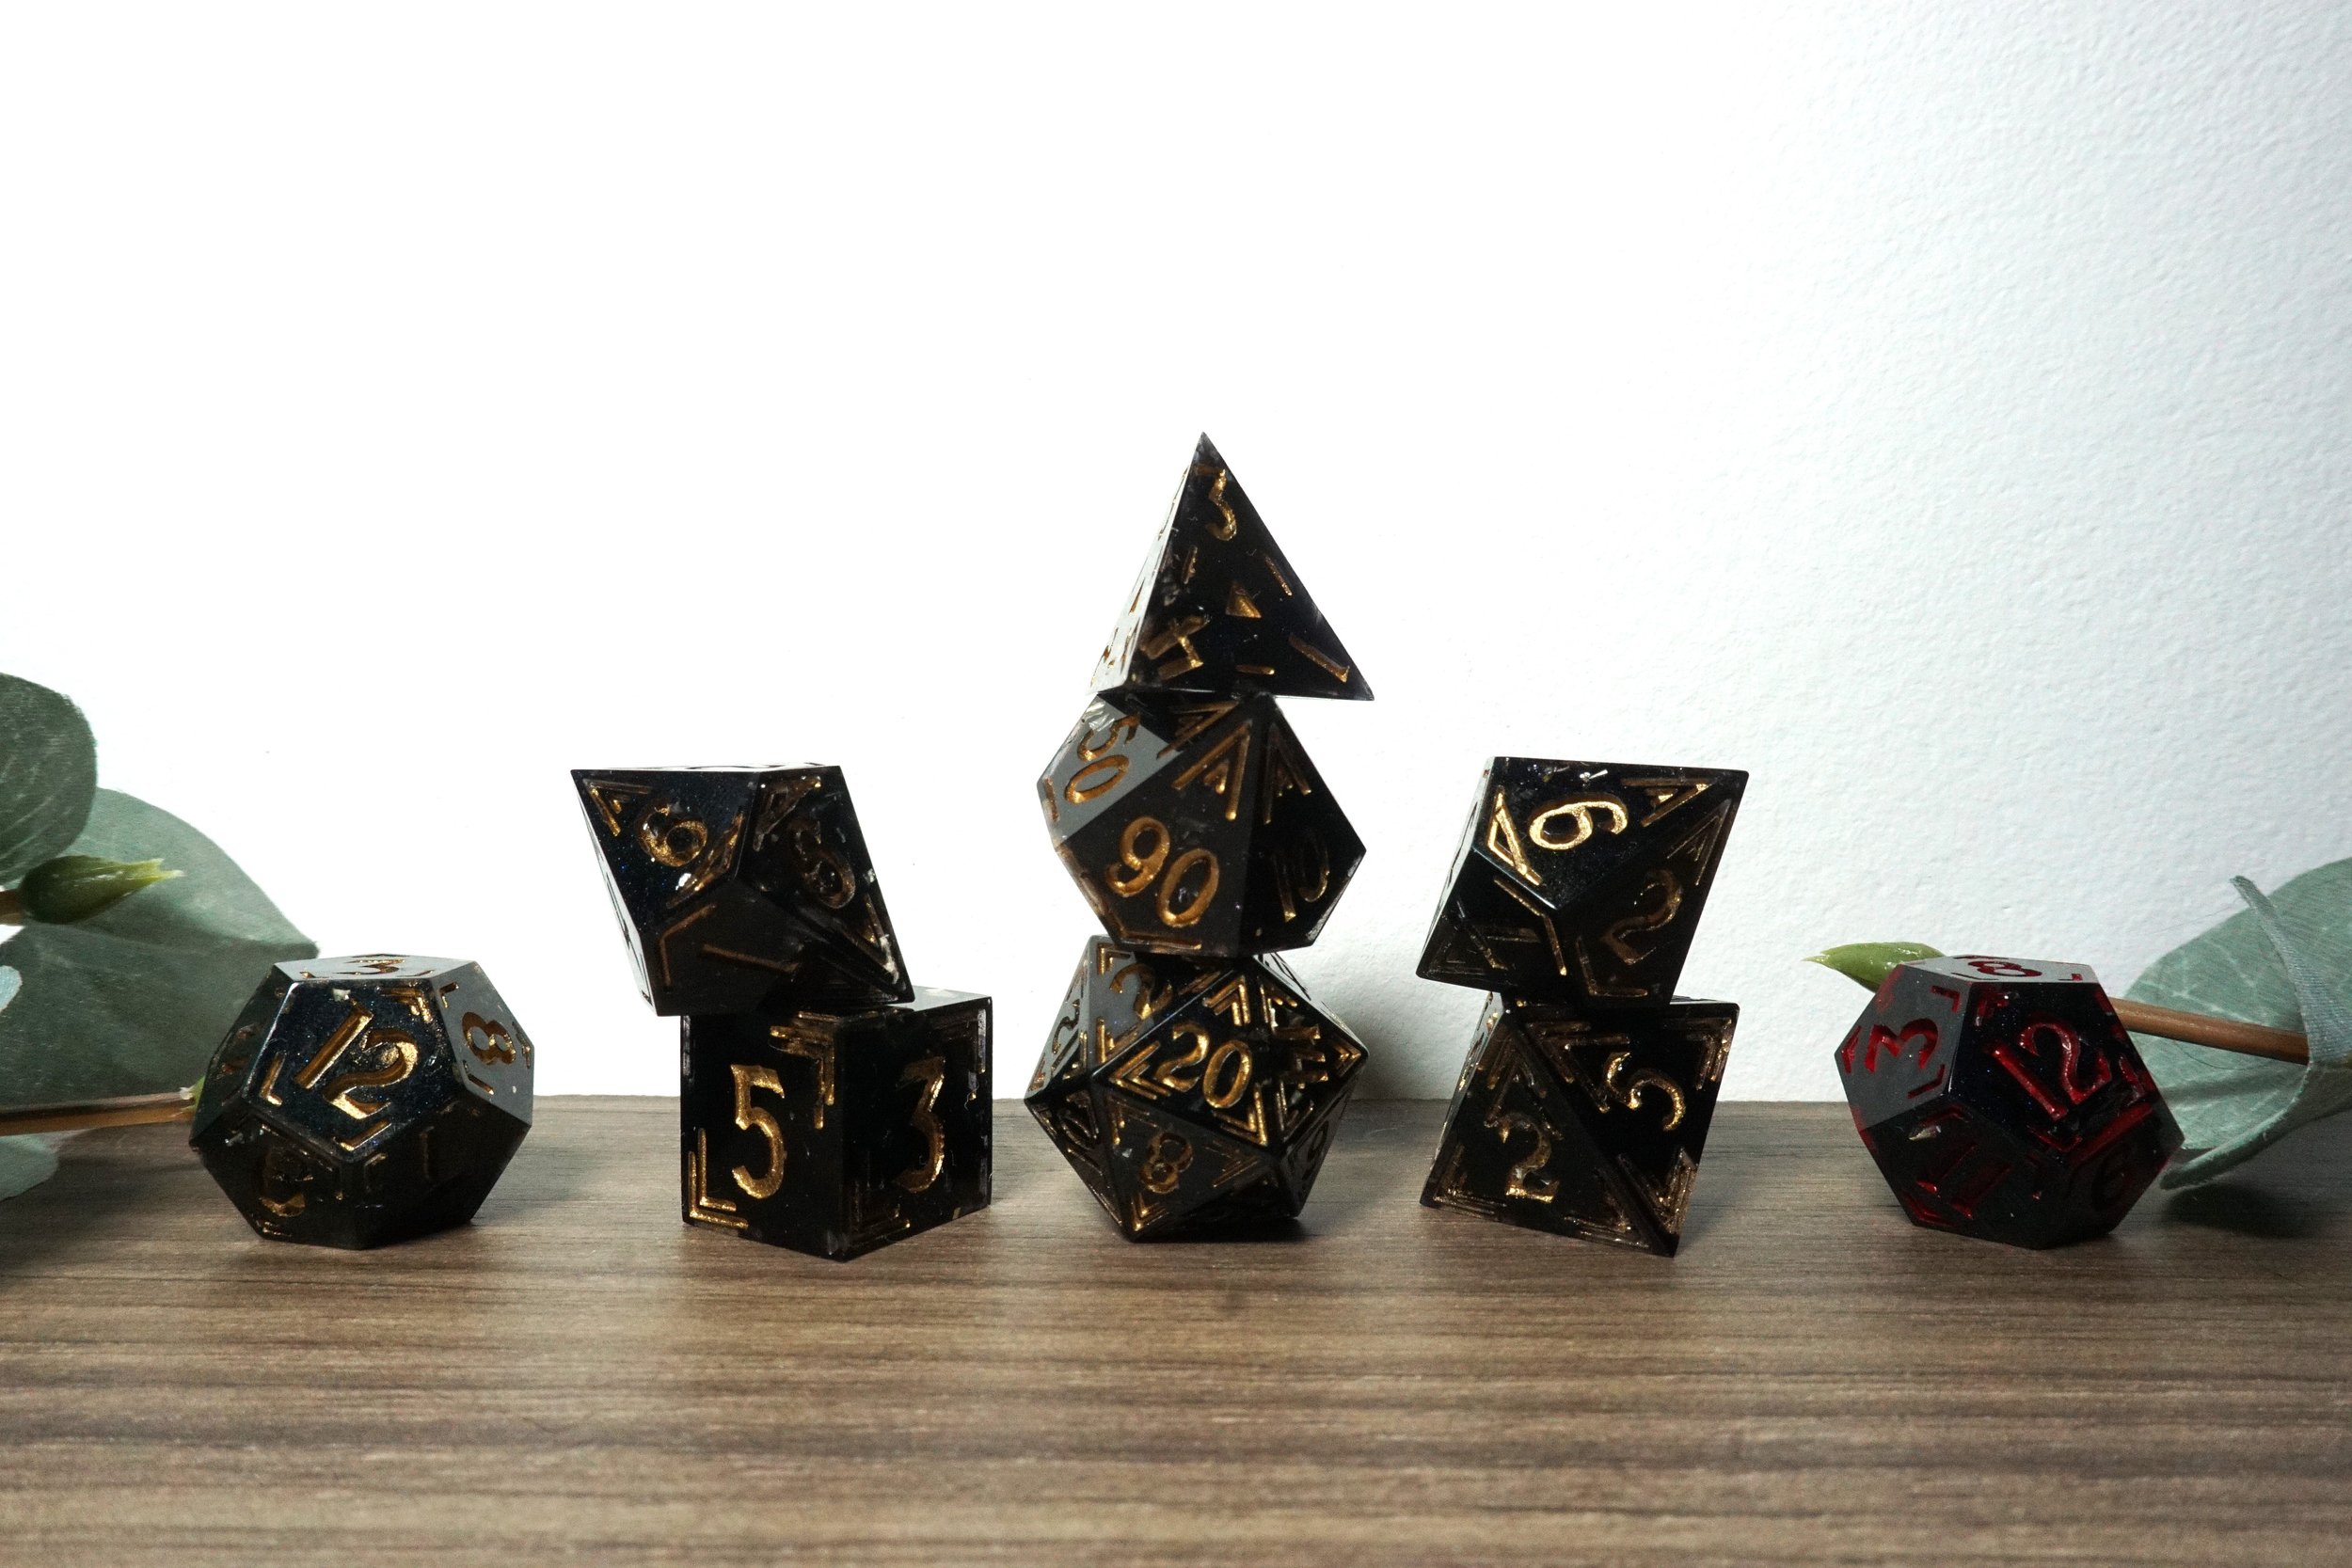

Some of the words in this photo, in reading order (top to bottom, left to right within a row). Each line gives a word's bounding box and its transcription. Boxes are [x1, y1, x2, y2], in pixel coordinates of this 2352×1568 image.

[1105, 816, 1220, 927] 90
[1603, 867, 1682, 966] 2
[293, 995, 420, 1120] 12
[461, 1010, 517, 1066] 8
[1155, 1020, 1253, 1109] 20
[1989, 1013, 2113, 1122] 12
[731, 1063, 788, 1200] 5
[894, 1055, 946, 1194] 3
[1606, 1051, 1687, 1132] 5
[1139, 1132, 1195, 1195] 8
[1497, 1111, 1561, 1204] 2
